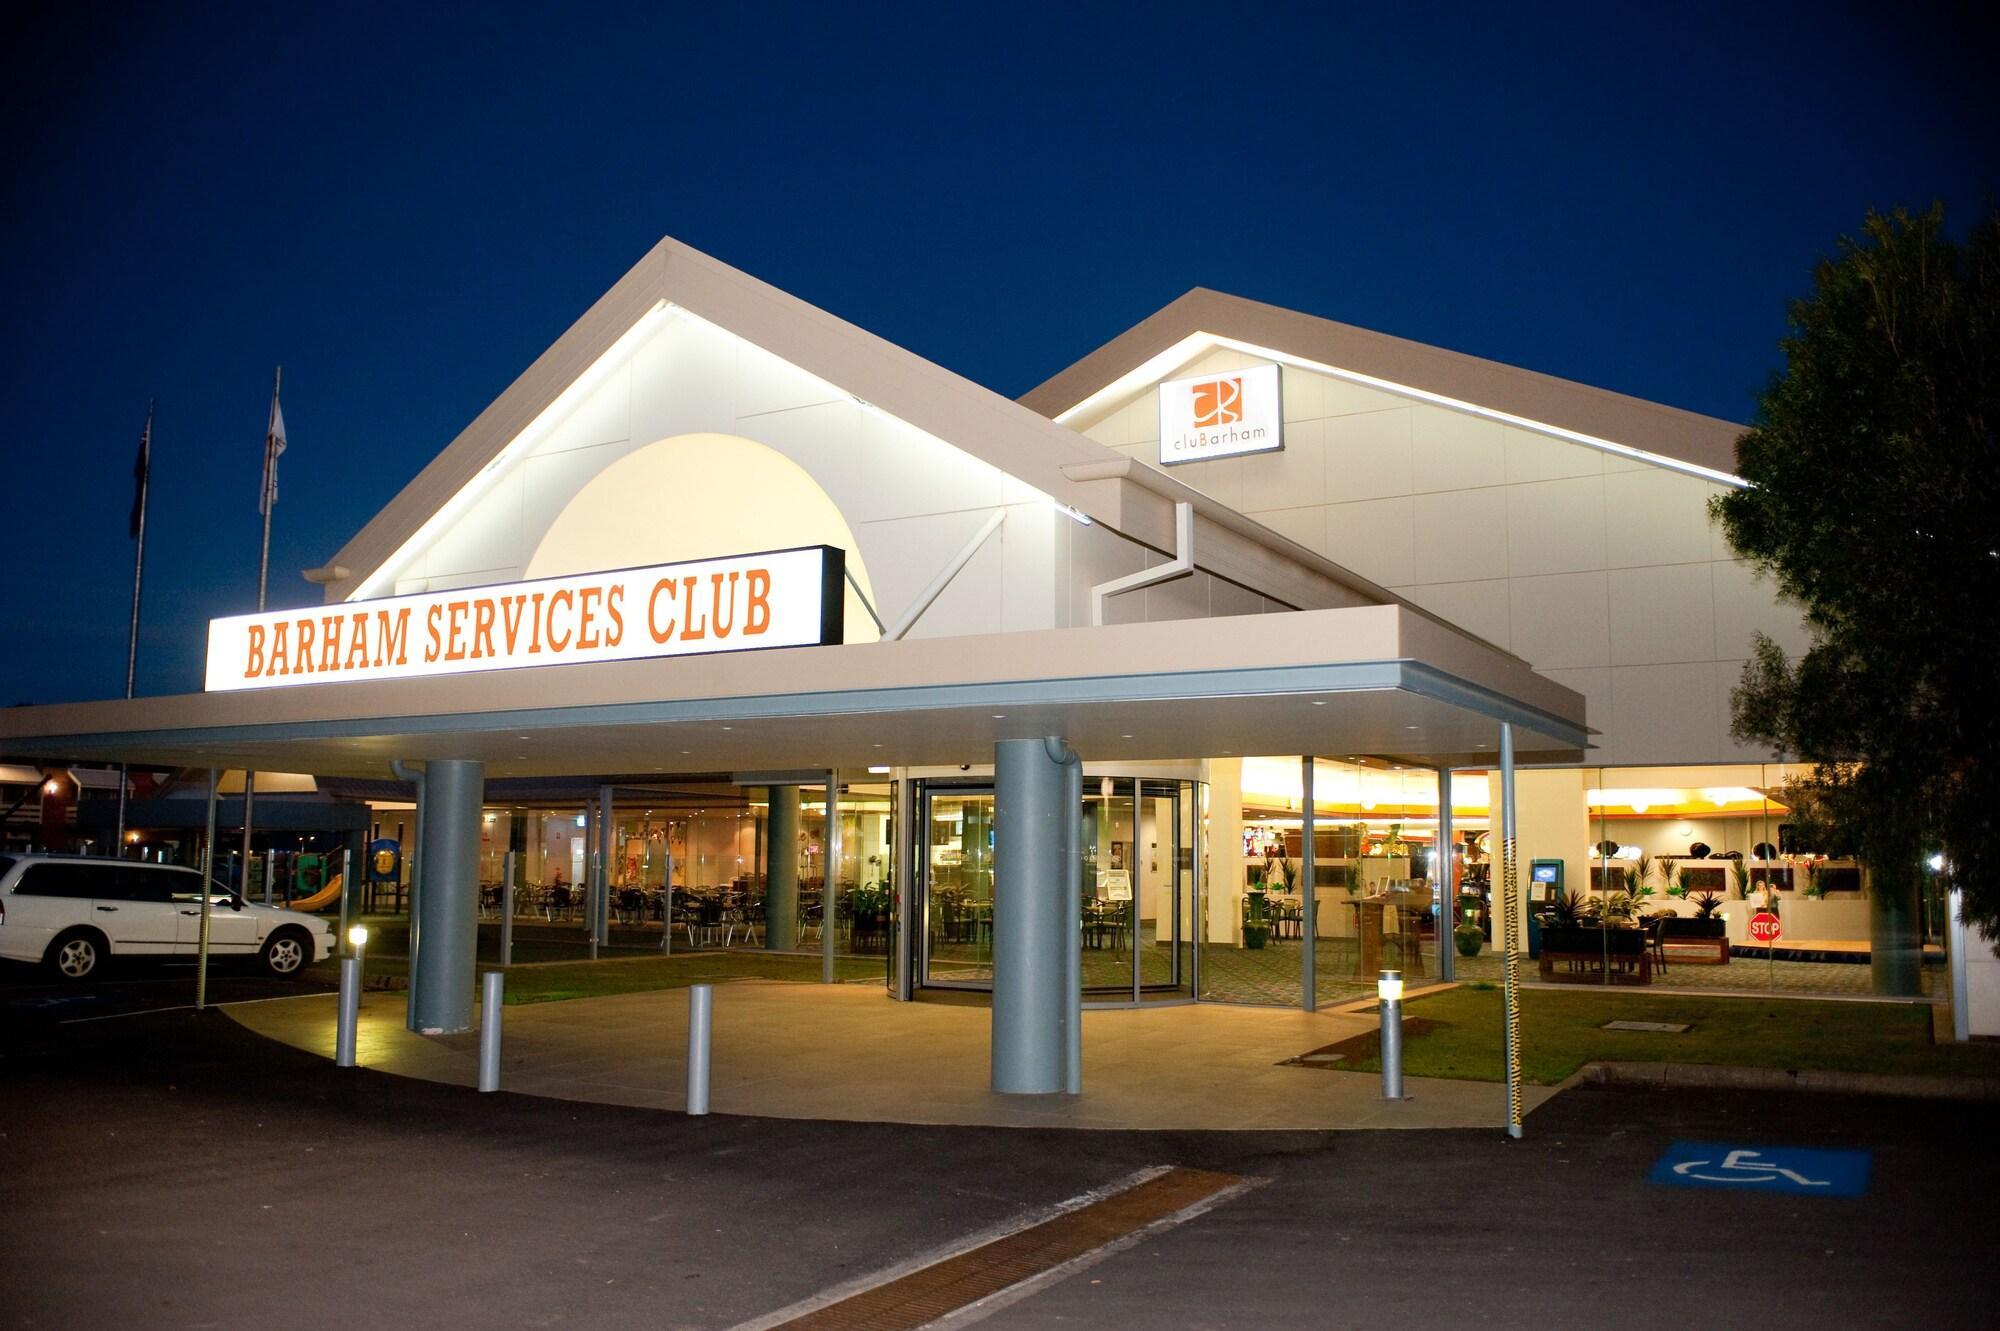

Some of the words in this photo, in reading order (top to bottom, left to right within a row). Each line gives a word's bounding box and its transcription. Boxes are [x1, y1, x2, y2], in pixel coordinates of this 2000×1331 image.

[1173, 426, 1266, 451] cluBarham
[243, 607, 412, 678] BARHAM
[424, 585, 625, 663] SERVICES
[648, 569, 771, 644] CLUB
